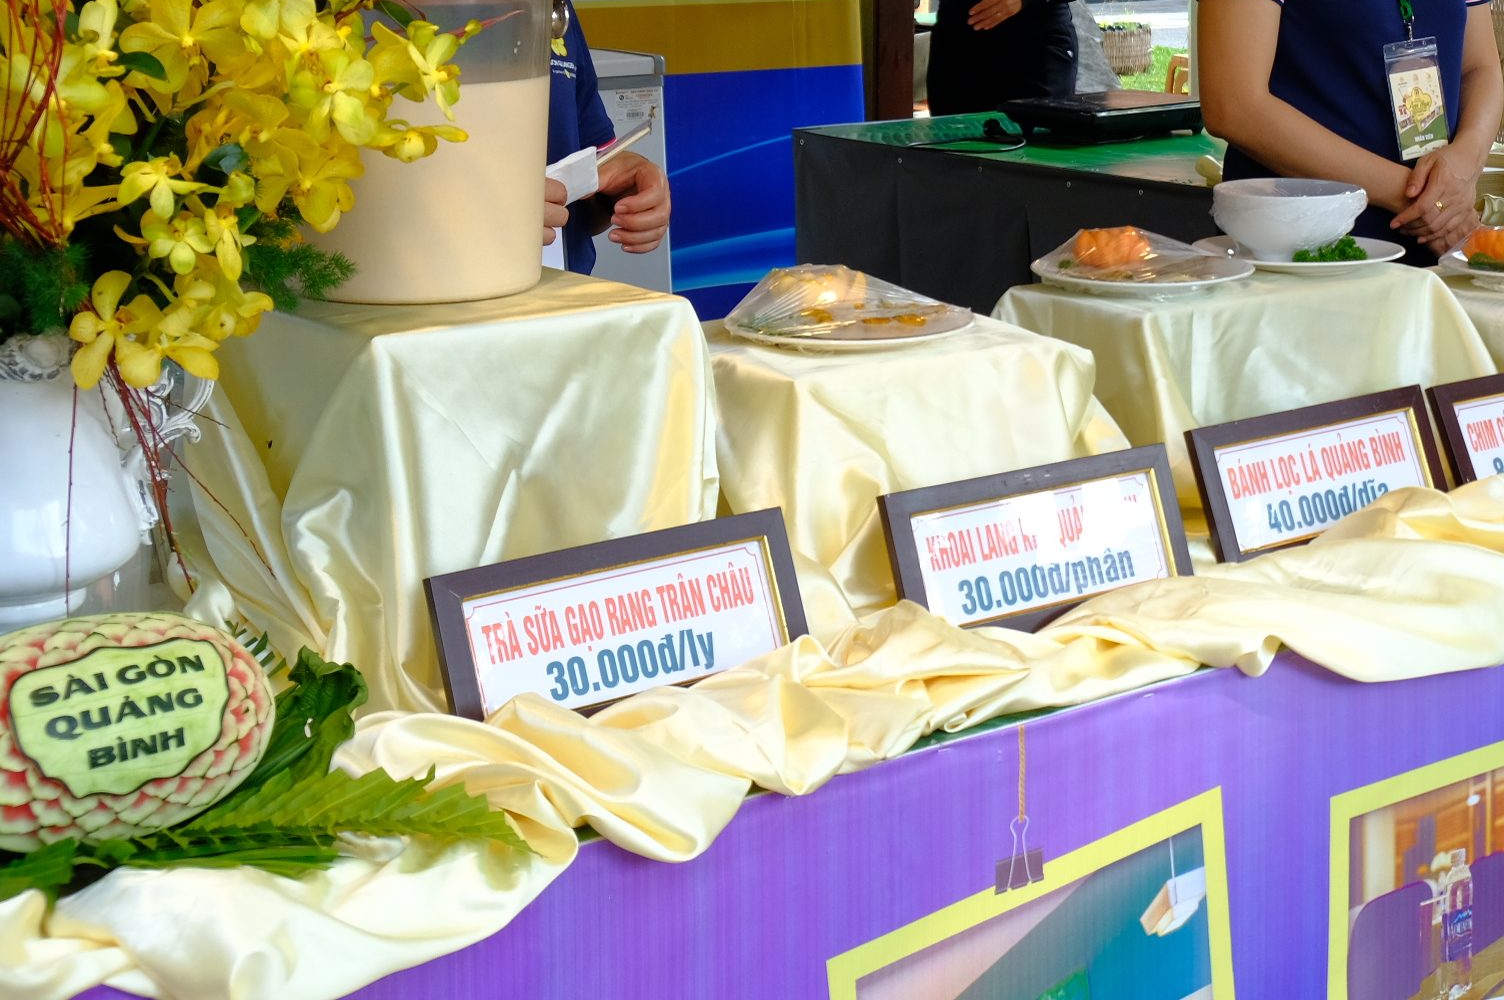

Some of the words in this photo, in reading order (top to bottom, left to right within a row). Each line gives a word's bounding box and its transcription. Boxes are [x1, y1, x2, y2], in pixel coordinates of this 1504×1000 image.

[1466, 419, 1500, 453] CHIM
[1226, 458, 1272, 500] BÁNH
[1269, 454, 1300, 495] LỌC
[1299, 443, 1322, 483] LÁ
[1320, 432, 1371, 482] QUẢNG
[1369, 428, 1406, 467] BÌNH
[925, 528, 977, 573] KHOAI
[481, 611, 523, 665] TRÀ
[523, 604, 564, 657] SỮA
[564, 600, 605, 651] GẠO
[605, 589, 657, 636] RANG
[656, 573, 707, 624] TRÂN
[706, 561, 755, 613] CHÂU
[29, 673, 109, 708] SÀI
[115, 655, 205, 686] GÒN
[546, 628, 716, 702] 30.000đ/ly
[45, 687, 203, 741] QUẢNG
[88, 727, 186, 770] BÌNH
